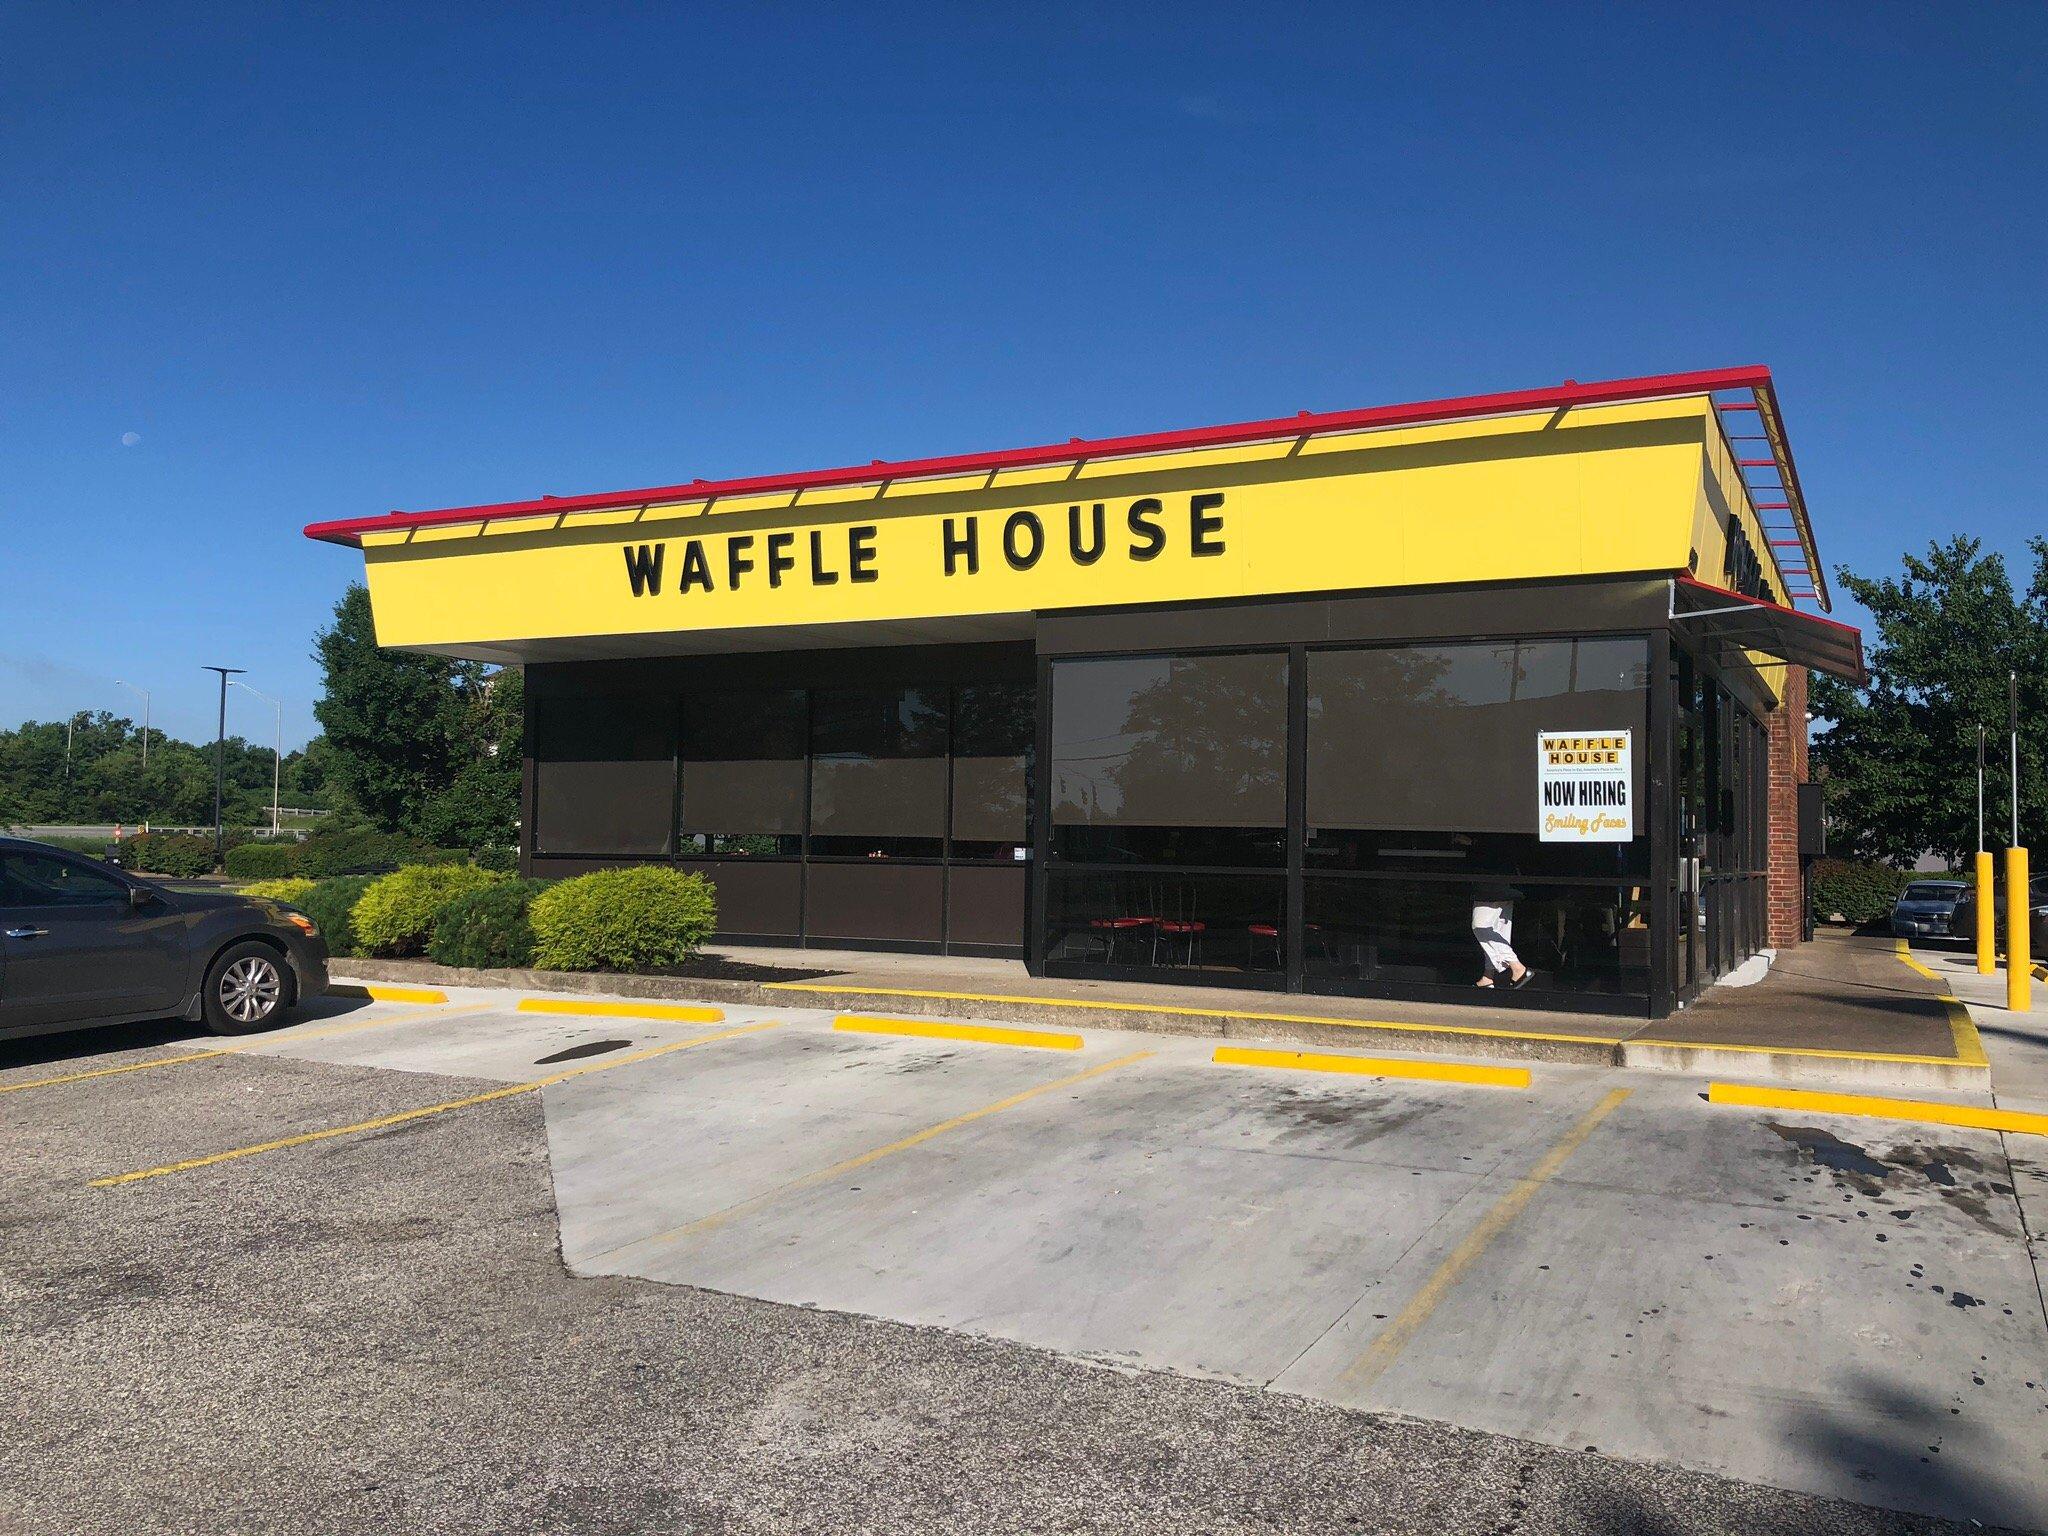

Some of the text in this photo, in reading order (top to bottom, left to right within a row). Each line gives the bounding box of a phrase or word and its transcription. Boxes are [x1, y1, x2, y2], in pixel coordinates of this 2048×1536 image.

[624, 493, 1226, 597] WAFFLE HOUSE
[1544, 738, 1624, 750] WAFFLE
[1550, 752, 1616, 764] HOUSE
[1544, 780, 1626, 806] NOW HIRING
[1545, 812, 1627, 835] Smiling Faces
